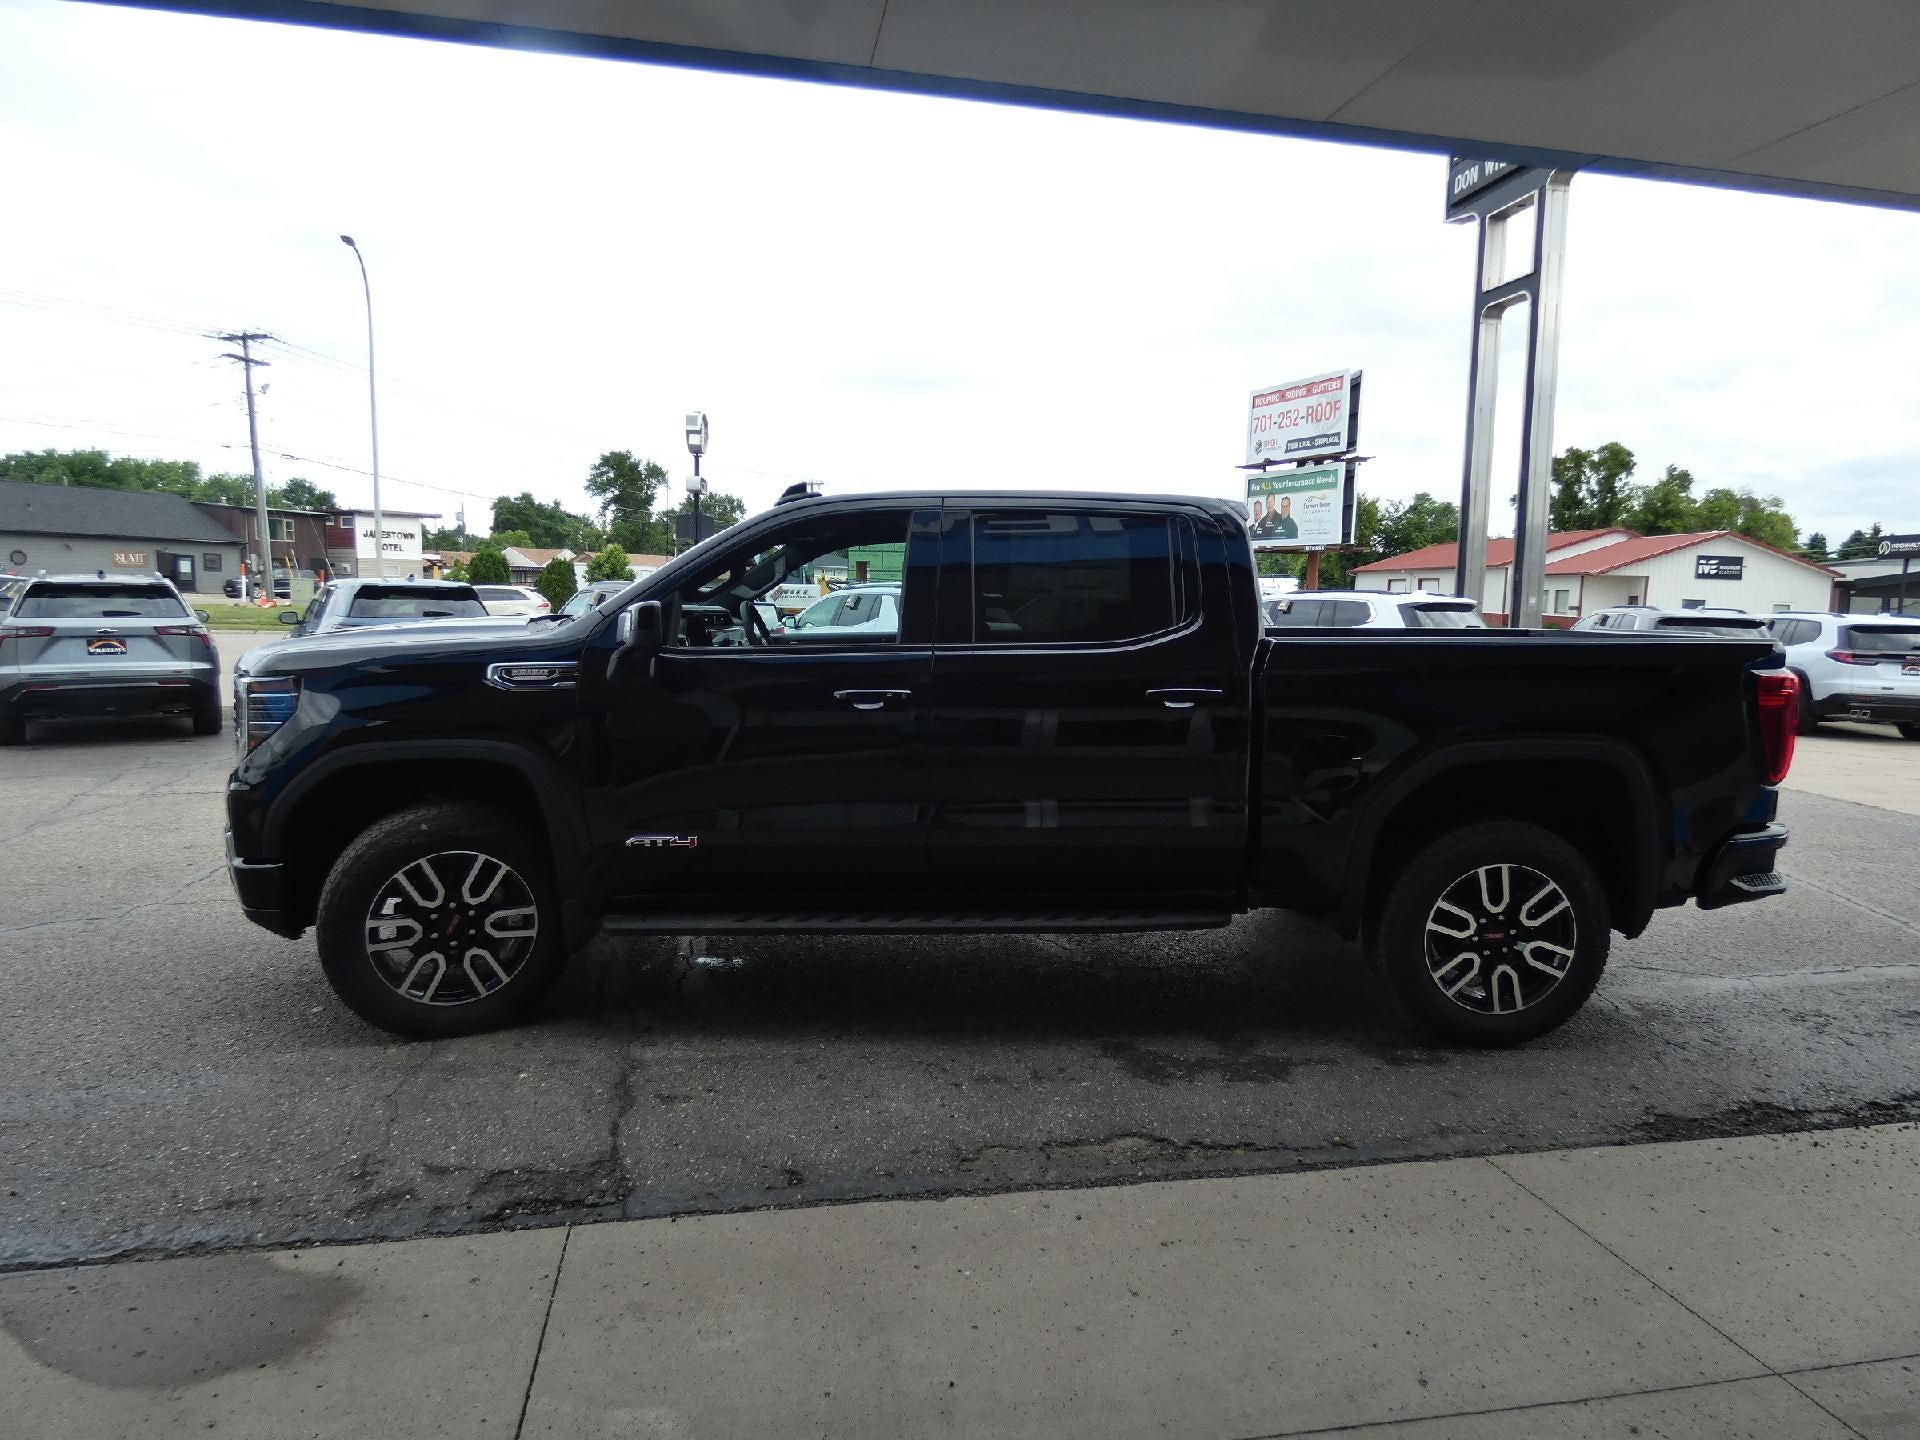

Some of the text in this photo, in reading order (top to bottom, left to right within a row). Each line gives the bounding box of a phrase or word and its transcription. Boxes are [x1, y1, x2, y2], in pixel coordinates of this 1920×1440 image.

[1453, 164, 1479, 194] DON
[1285, 387, 1307, 400] SIDING
[1312, 380, 1341, 394] GUTTERS
[1253, 399, 1342, 434] 701-252-ROOF
[1251, 474, 1336, 491] For ALL Your Insurance Needs
[382, 543, 405, 552] OTEL
[625, 836, 698, 849] AT4
